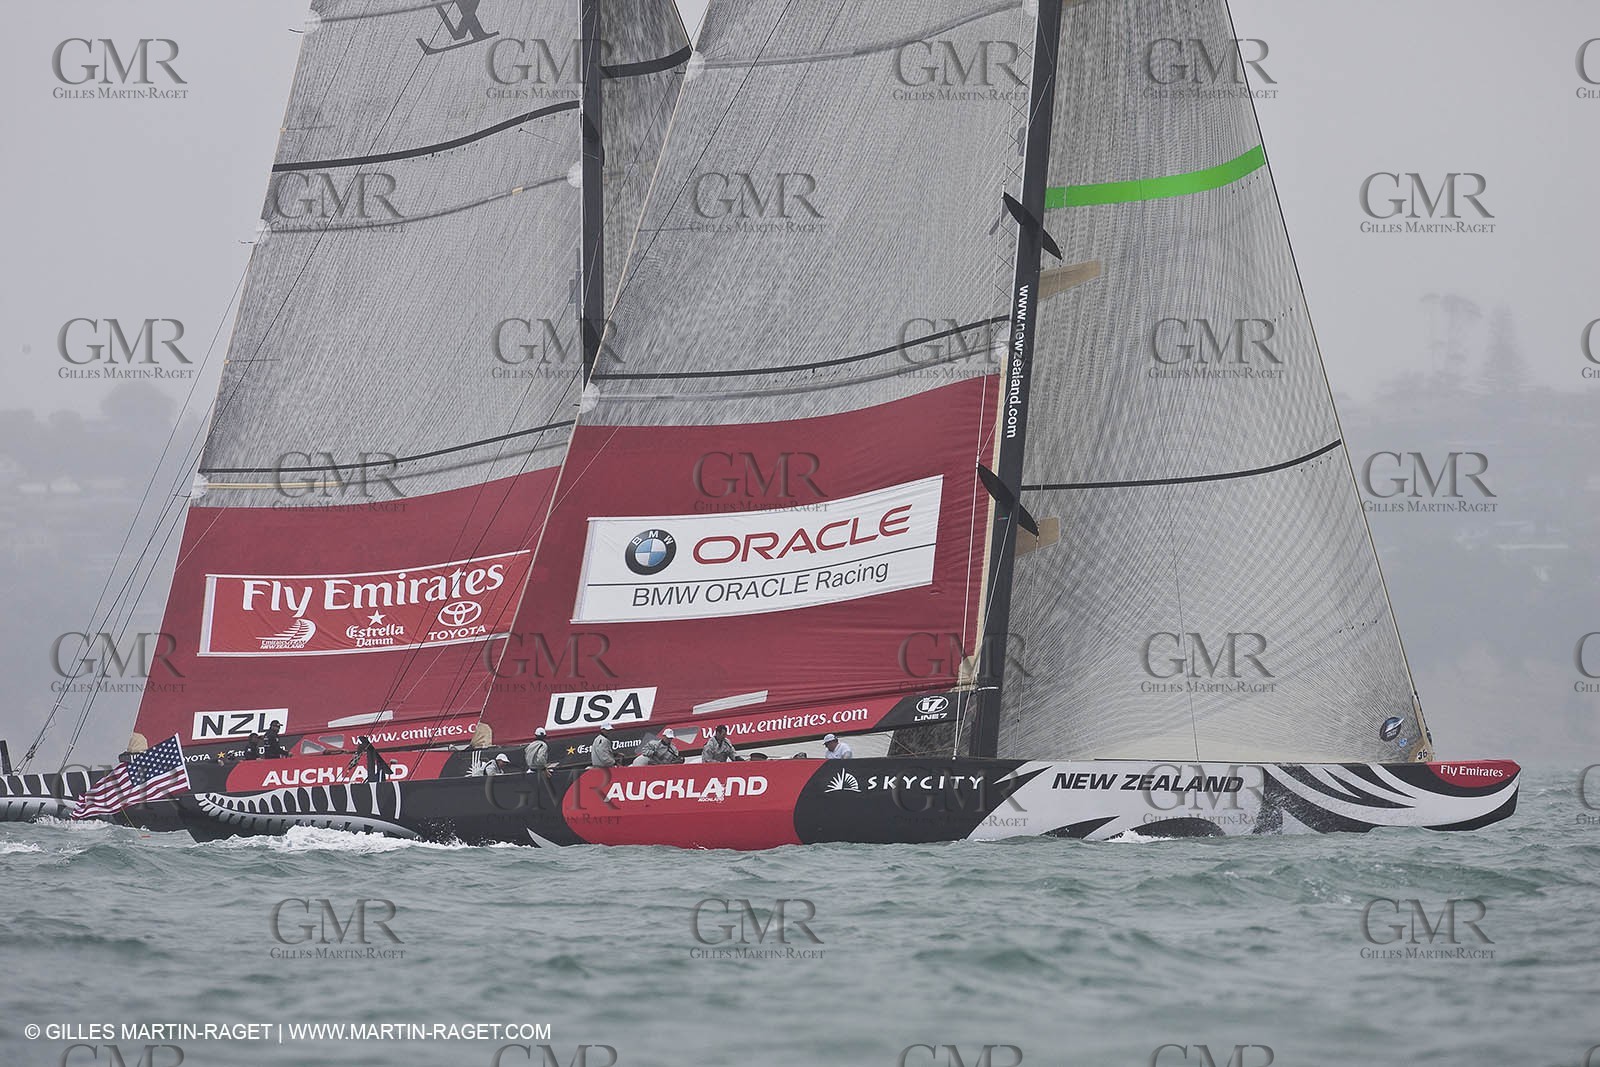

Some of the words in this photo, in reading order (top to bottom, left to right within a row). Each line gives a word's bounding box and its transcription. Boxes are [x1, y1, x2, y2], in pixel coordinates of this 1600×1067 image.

[1006, 284, 1029, 438] www.newzealand.com
[692, 504, 913, 565] ORACLE
[242, 579, 313, 618] Fly
[323, 563, 505, 610] Emirates
[632, 585, 700, 607] BMW
[704, 574, 811, 603] ORACLE
[815, 562, 889, 591] Racing
[345, 623, 405, 639] Estrella
[355, 636, 394, 648] Damm
[428, 624, 487, 640] TOYOTA
[553, 692, 644, 726] USA
[200, 712, 271, 737] NZL
[867, 775, 984, 790] SKYCITY
[1052, 772, 1119, 790] NEW
[1120, 774, 1244, 793] ZEALAND
[1440, 765, 1457, 777] Fly
[1459, 765, 1504, 777] Emirates
[603, 775, 769, 802] AUCKLAND
